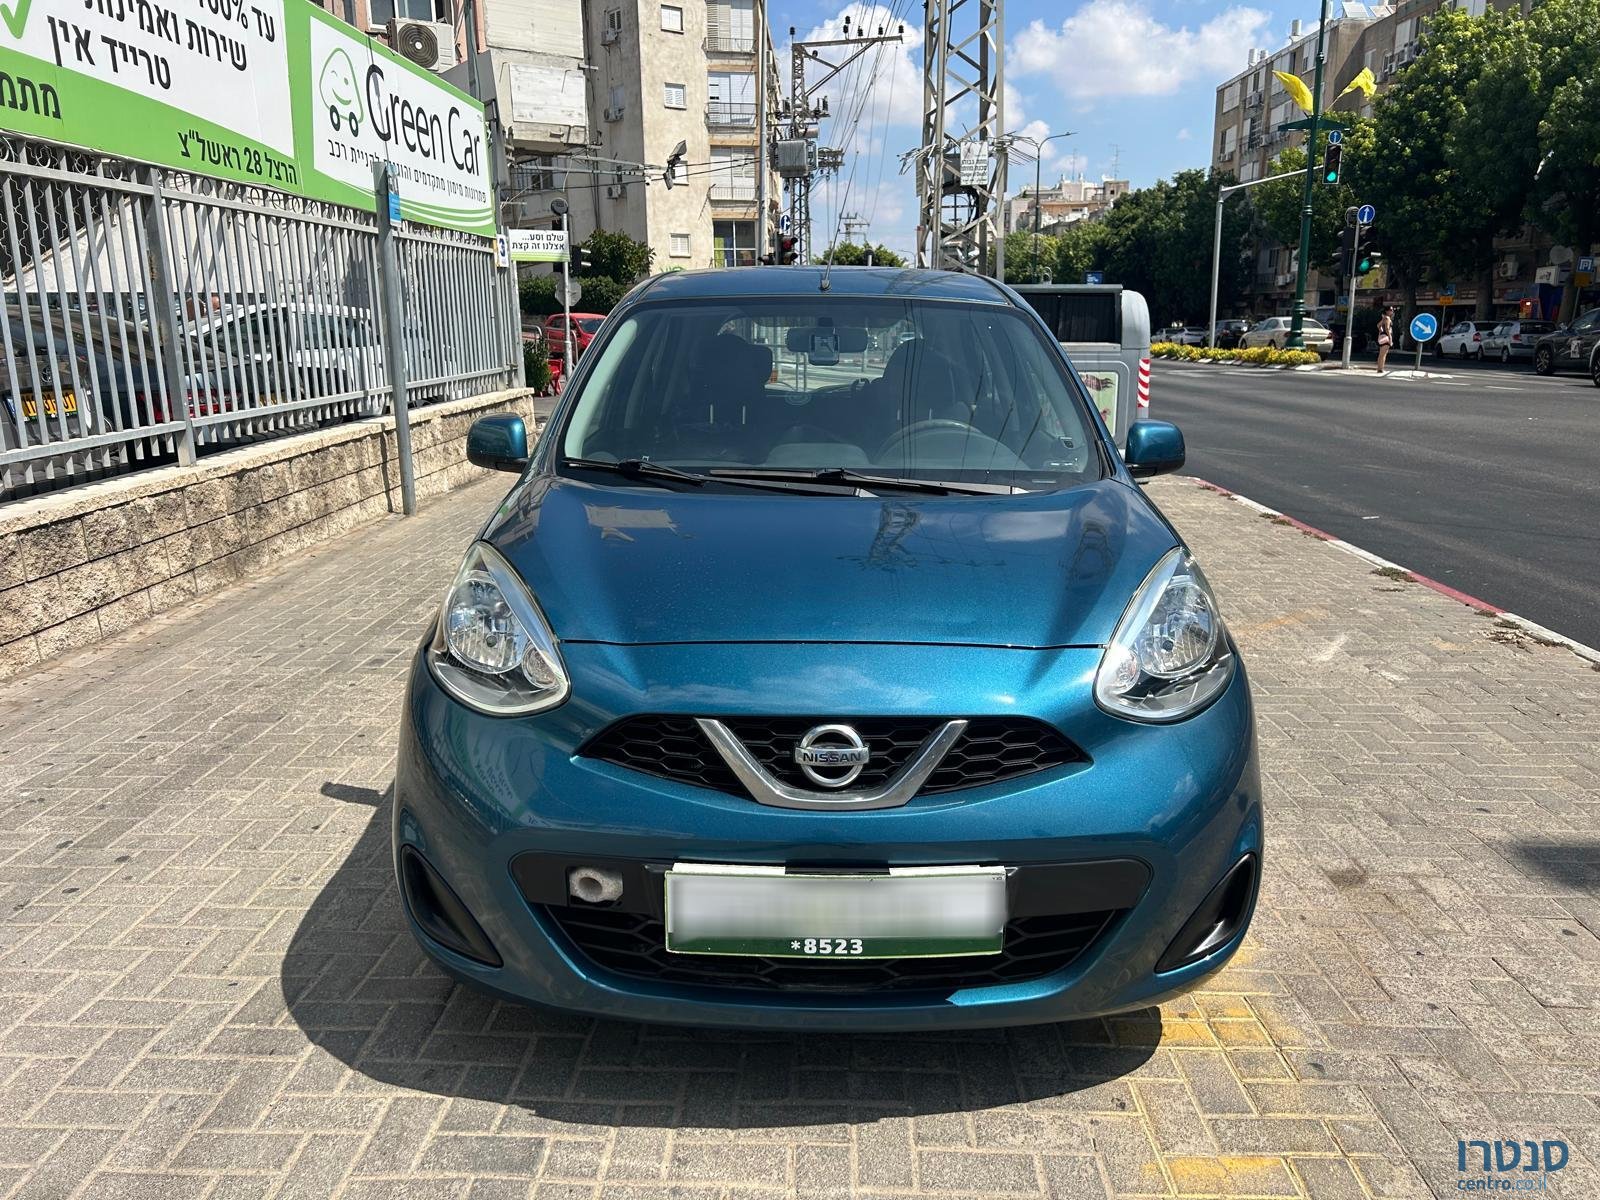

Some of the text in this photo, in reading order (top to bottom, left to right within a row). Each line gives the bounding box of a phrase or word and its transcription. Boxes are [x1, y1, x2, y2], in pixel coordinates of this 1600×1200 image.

[199, 0, 275, 43] עד 0%
[47, 15, 171, 90] טרייד אין
[185, 18, 247, 71] שירות
[366, 63, 480, 177] Green Car
[243, 146, 263, 176] 28
[327, 138, 347, 161] רכב
[264, 151, 298, 185] הרצל
[414, 169, 446, 192] מתקדמים
[447, 179, 463, 196] מימון
[512, 242, 565, 251] אצלנו זה קצת
[546, 233, 564, 241] שלם
[803, 752, 861, 763] NISSAN
